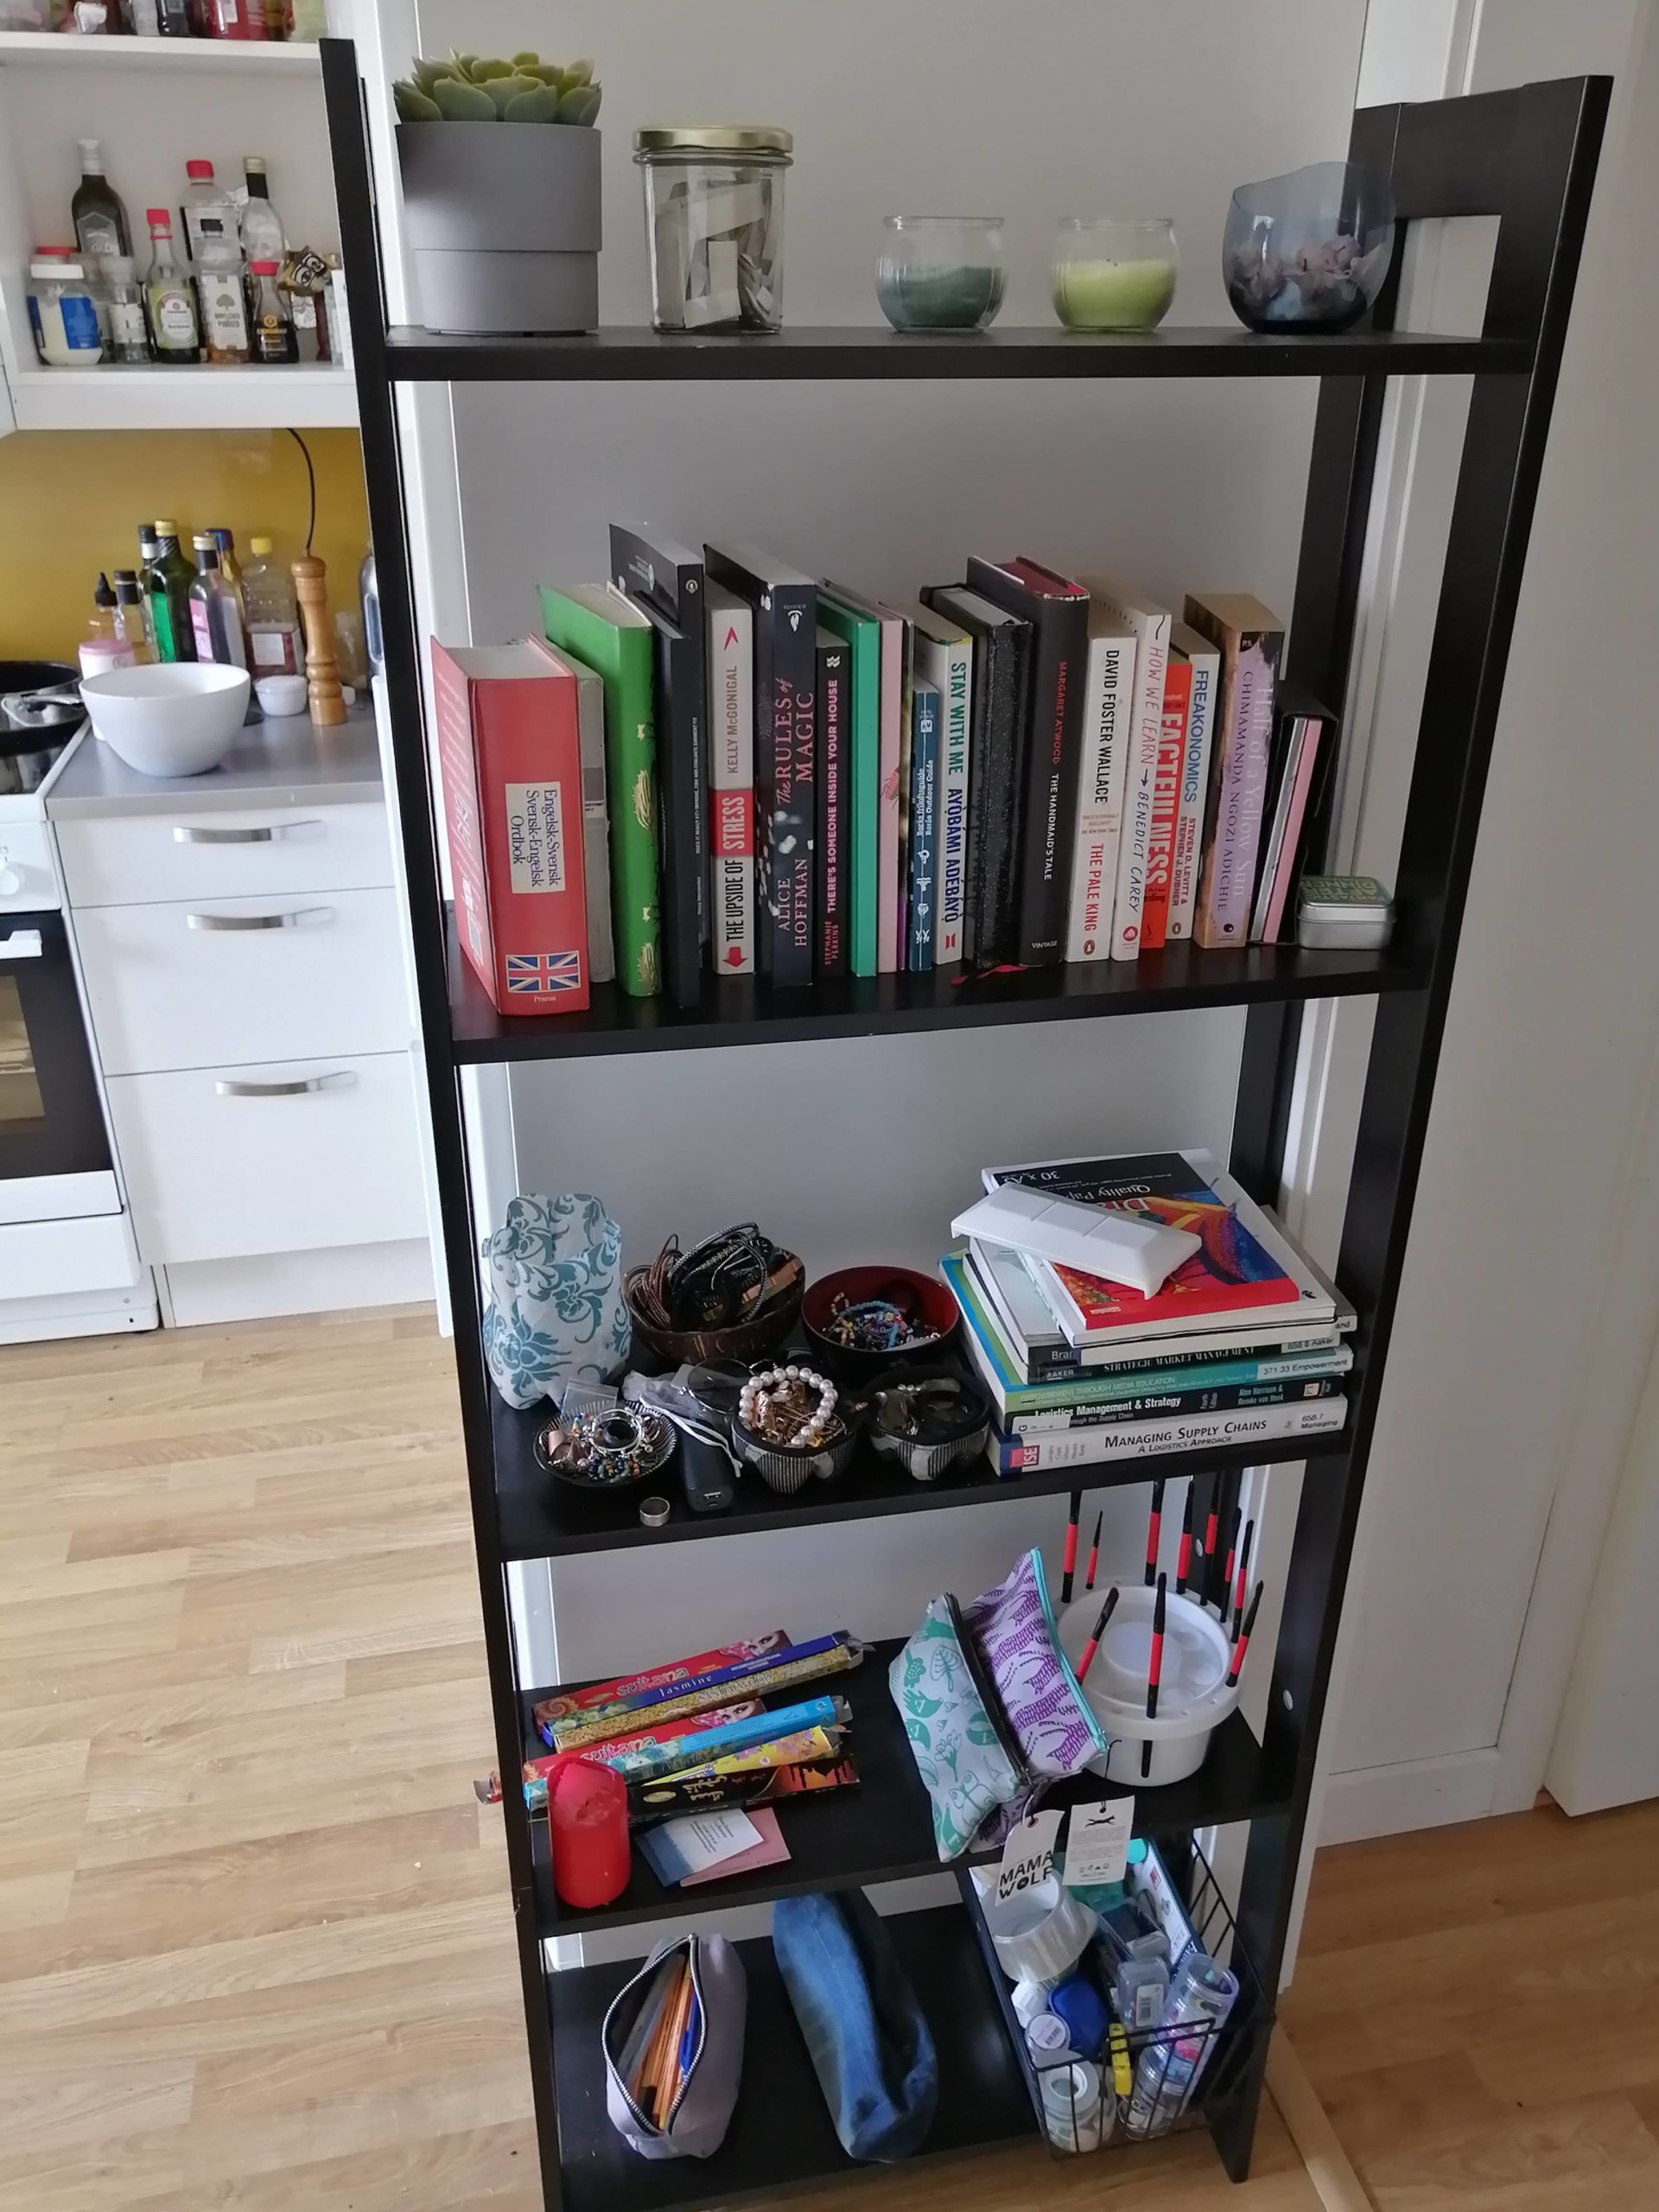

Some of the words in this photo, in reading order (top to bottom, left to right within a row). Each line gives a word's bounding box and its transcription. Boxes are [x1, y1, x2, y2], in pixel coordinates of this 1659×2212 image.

[950, 662, 966, 699] STAY
[1103, 650, 1120, 689] DAVID
[1147, 646, 1164, 681] HOW
[726, 665, 738, 735] McGONIGAL
[775, 677, 793, 694] of
[829, 679, 838, 722] HOUSE
[1056, 662, 1067, 717] MARGARET
[1145, 688, 1160, 710] WE
[950, 704, 965, 747] WITH
[1099, 694, 1116, 742] FOSTER
[1252, 688, 1274, 729] Half
[775, 697, 791, 779] RULES
[796, 692, 814, 782] MAGIC
[828, 726, 837, 760] YOUR
[1052, 719, 1063, 765] ATWOOD
[1141, 718, 1158, 765] LEARN
[1185, 670, 1209, 804] FREAKONOMICS
[1231, 671, 1253, 785] CHIMAMANDA
[727, 739, 738, 773] KELLY
[949, 751, 963, 776] ME
[1249, 741, 1266, 765] of
[828, 764, 837, 804] INSIDE
[1050, 773, 1059, 792] THE
[1095, 746, 1112, 804] WALLACE
[722, 796, 745, 850] STRESS
[827, 807, 837, 863] SOMEONE
[1046, 794, 1058, 856] HANDMAID'S
[1134, 791, 1149, 860] BENEDICT
[1225, 791, 1240, 842] NGOZI
[1238, 785, 1262, 851] Yellow
[511, 815, 525, 864] Ordbok
[526, 790, 544, 887] Svensk-Engelsk
[542, 790, 561, 887] Engelsk-Svensk
[1177, 816, 1187, 858] STEPHEN
[1185, 817, 1196, 854] STEVEN
[725, 859, 743, 874] OF
[1044, 858, 1053, 880] TALE
[1090, 843, 1103, 866] THE
[1175, 859, 1183, 868] J.
[1185, 855, 1192, 864] D.
[726, 876, 743, 918] UPSIDE
[827, 866, 836, 913] THERE'S
[1087, 870, 1101, 899] PALE
[1129, 867, 1142, 912] CAREY
[1172, 869, 1182, 906] DUBNER
[1182, 866, 1192, 896] LEVITT
[1217, 849, 1234, 912] ADICHIE
[1233, 861, 1251, 897] Sun
[778, 878, 791, 931] ALICE
[795, 858, 808, 947] HOFFMAN
[1084, 903, 1099, 931] KING
[727, 920, 743, 942] THE
[1031, 940, 1058, 949] VINTAGE
[1040, 1170, 1060, 1180] 30
[1098, 1184, 1151, 1199] Quality
[1066, 1191, 1095, 1200] Pap
[1104, 1357, 1154, 1373] STRATEGIC
[1156, 1352, 1192, 1365] MARKET
[1195, 1346, 1255, 1361] MANAGEMENT
[1293, 1358, 1348, 1371] Empowerment
[1076, 1384, 1112, 1395] THROUGH
[1077, 1402, 1133, 1416] Management
[1134, 1399, 1142, 1409] &
[1144, 1396, 1181, 1409] Strategy
[1104, 1431, 1173, 1449] MANAGING
[1178, 1425, 1219, 1440] SUPPLY
[1224, 1420, 1267, 1434] CHAINS
[1300, 1420, 1338, 1429] Managing
[1301, 1413, 1324, 1421] 658.7
[1023, 1446, 1038, 1465] ISE
[1148, 1440, 1187, 1452] LOGISTICS
[1190, 1435, 1232, 1446] APPROACH
[616, 1666, 690, 1697] sultana
[658, 1675, 713, 1698] Jasmine
[998, 1867, 1052, 1900] WOLF
[999, 1850, 1054, 1888] MAMA
